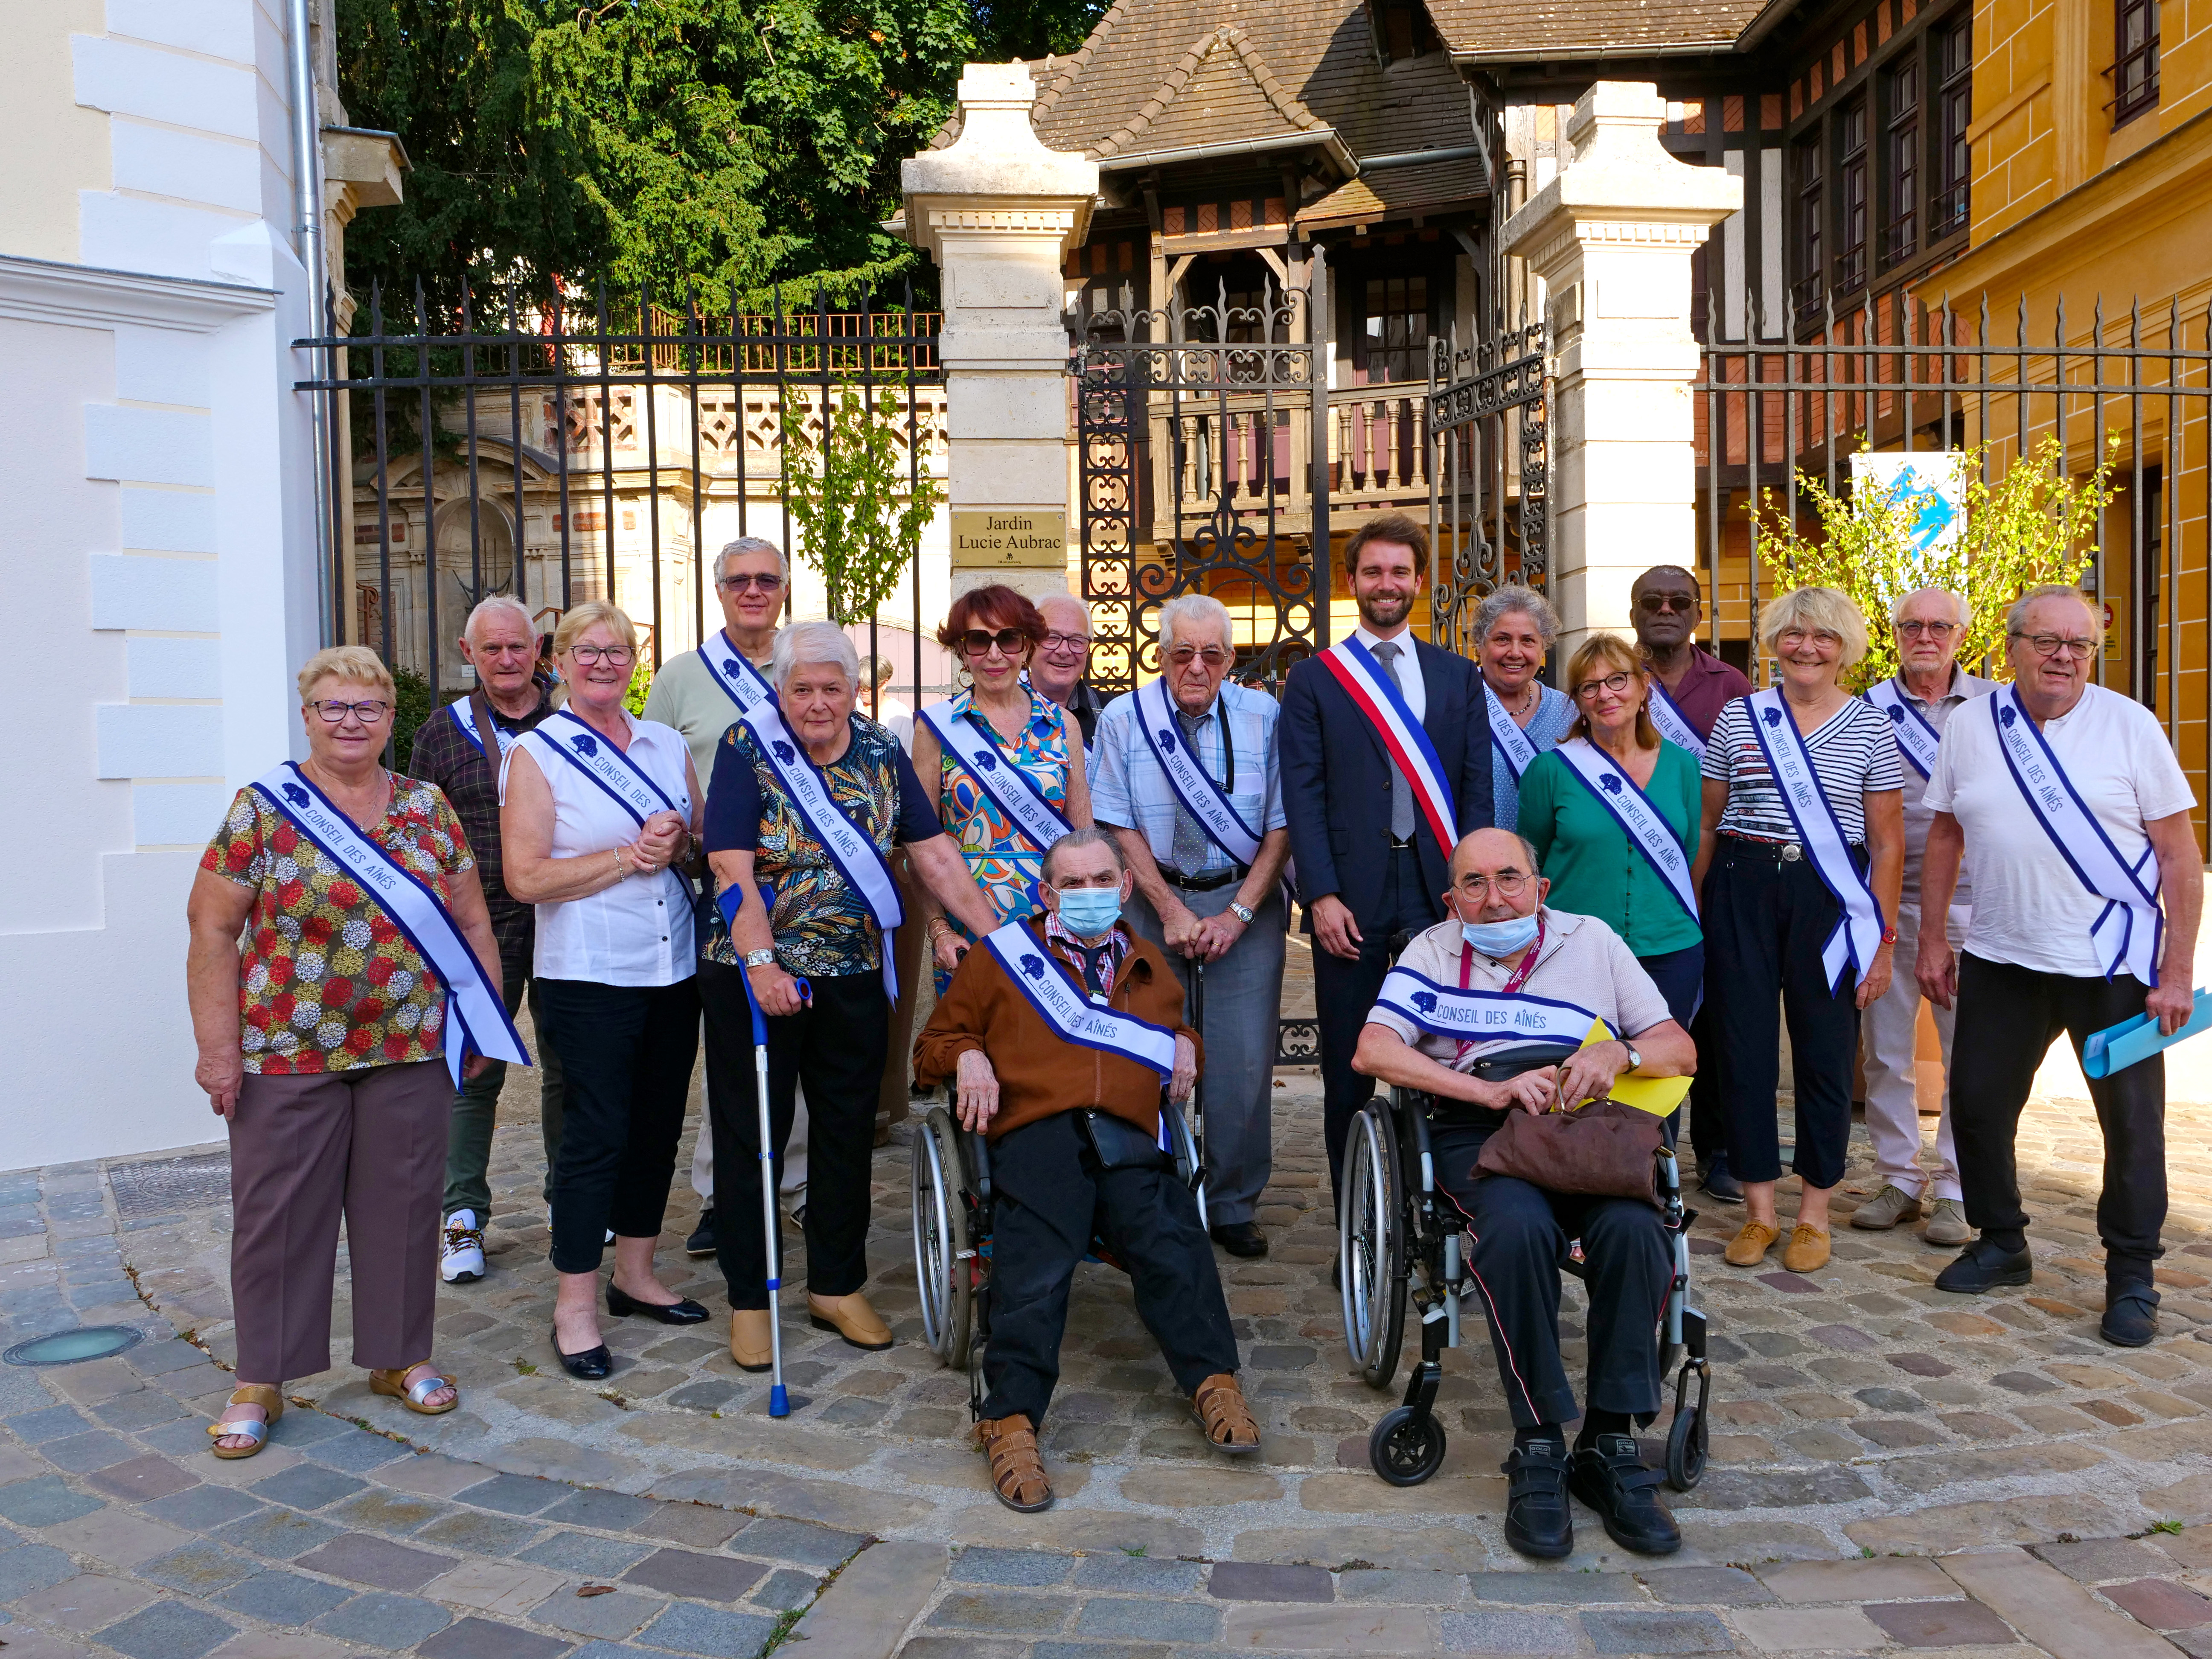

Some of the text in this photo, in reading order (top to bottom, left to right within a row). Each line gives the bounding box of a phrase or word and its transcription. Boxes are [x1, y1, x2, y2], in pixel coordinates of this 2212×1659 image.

[958, 535, 1061, 549] Lucie Aubrac
[986, 516, 1033, 530] Jardin
[736, 678, 762, 706] CONSEI
[1496, 719, 1513, 736] DES
[1508, 739, 1529, 763] AÎNÉS
[1649, 702, 1674, 732] CONSEIL
[1670, 729, 1688, 746] DES
[1900, 723, 1936, 766] CONSEIL DE
[594, 757, 651, 809] CONSEIL DES
[1170, 755, 1196, 792] CONSEIL
[1192, 789, 1211, 809] DES
[1206, 811, 1230, 833] AÎNÉS
[1770, 728, 1812, 808] CONSEIL DES AÎNÉS
[2007, 728, 2063, 812] CONSEIL DES AÎNÉS
[789, 767, 858, 858] CONSEIL DES AÎNÉS
[990, 771, 1060, 844] CONSEIL DES AÎNÉS
[1616, 795, 1679, 871] CONSEIL DES AÎNÉS
[305, 810, 397, 890] CONSEIL DES AÎNÉS
[1038, 979, 1118, 1039] CONSEIL DES AÎNÉS
[1437, 1004, 1547, 1029] CONSEIL DES AÎNÉS
